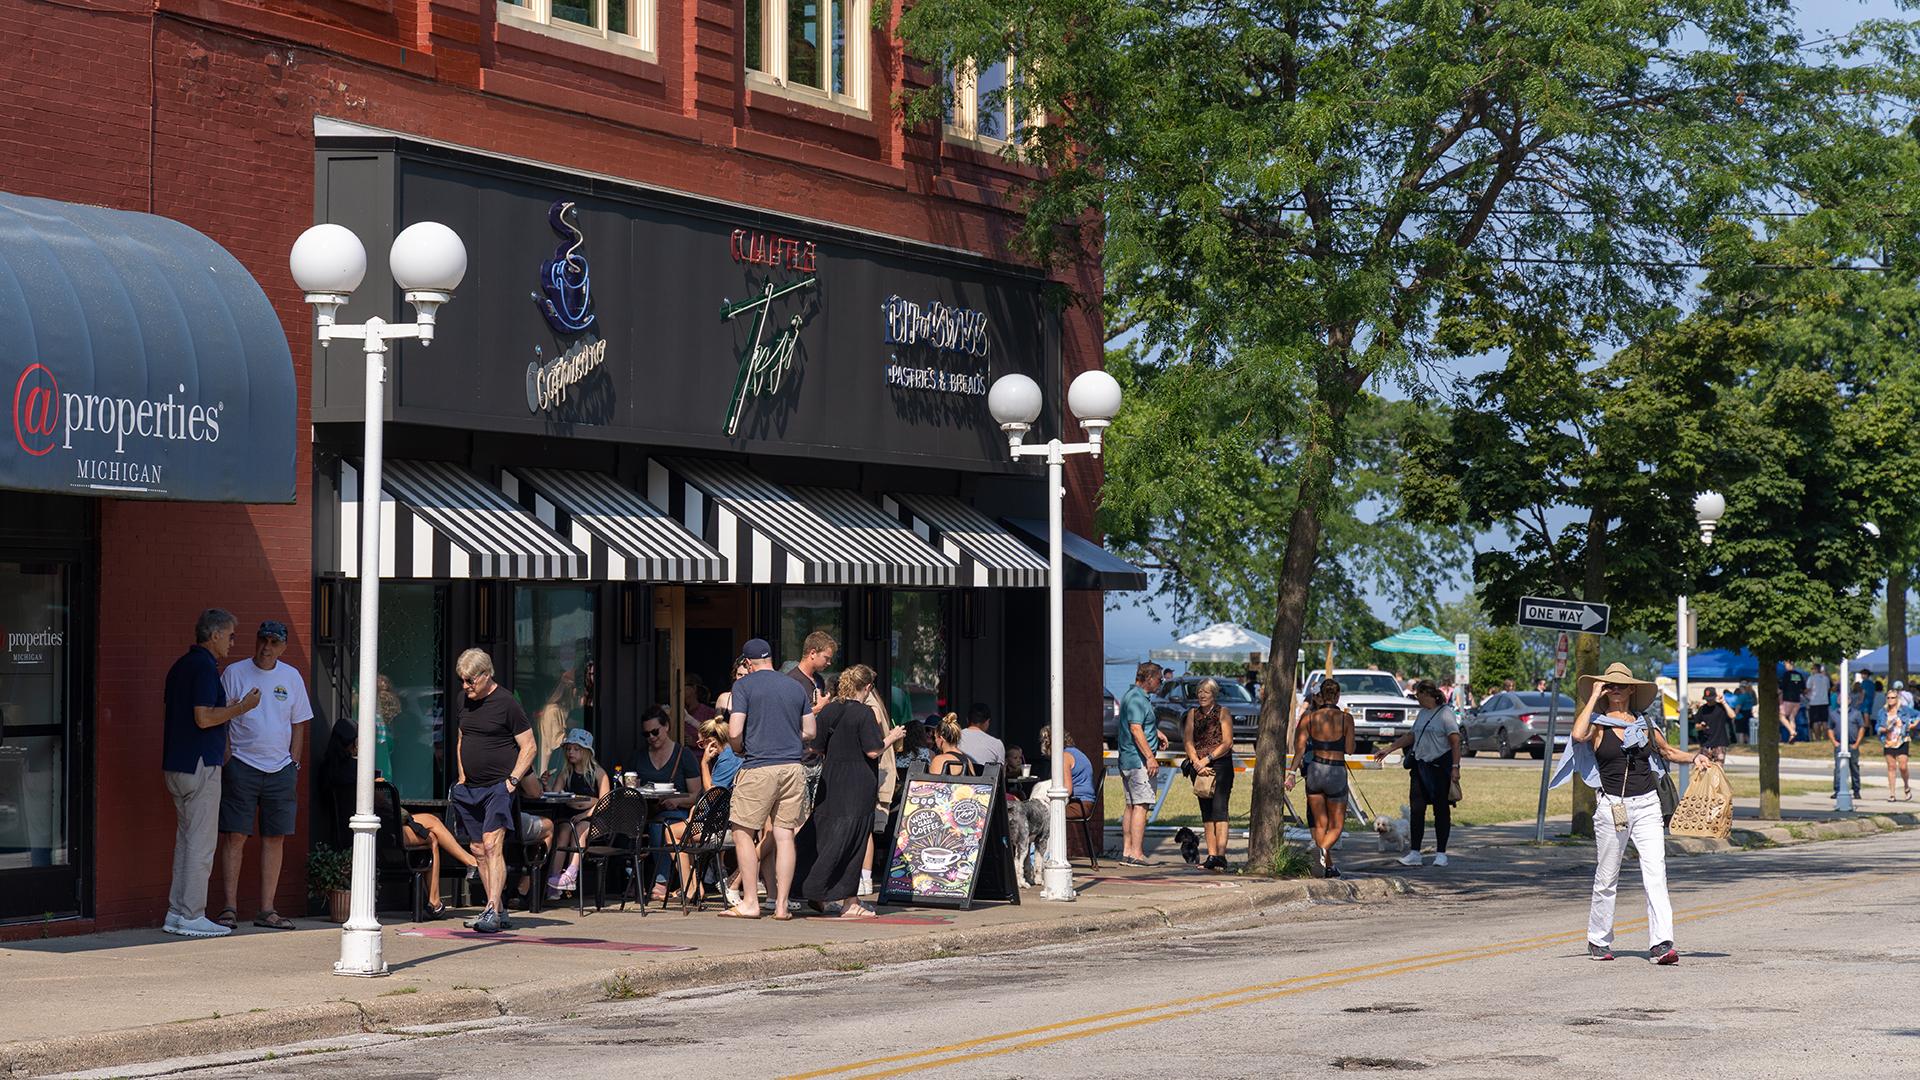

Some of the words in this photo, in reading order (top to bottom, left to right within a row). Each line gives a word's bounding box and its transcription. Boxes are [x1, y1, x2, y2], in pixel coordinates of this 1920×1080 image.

[887, 364, 936, 390] PASTRIES
[938, 370, 947, 391] &
[949, 373, 986, 396] BREADS
[76, 459, 162, 484] MICHIGAN
[1528, 606, 1555, 620] ONE
[1559, 609, 1584, 623] WAY
[13, 653, 43, 661] MICHIGAN
[910, 811, 936, 824] WORLD
[911, 821, 941, 836] COFFEE
